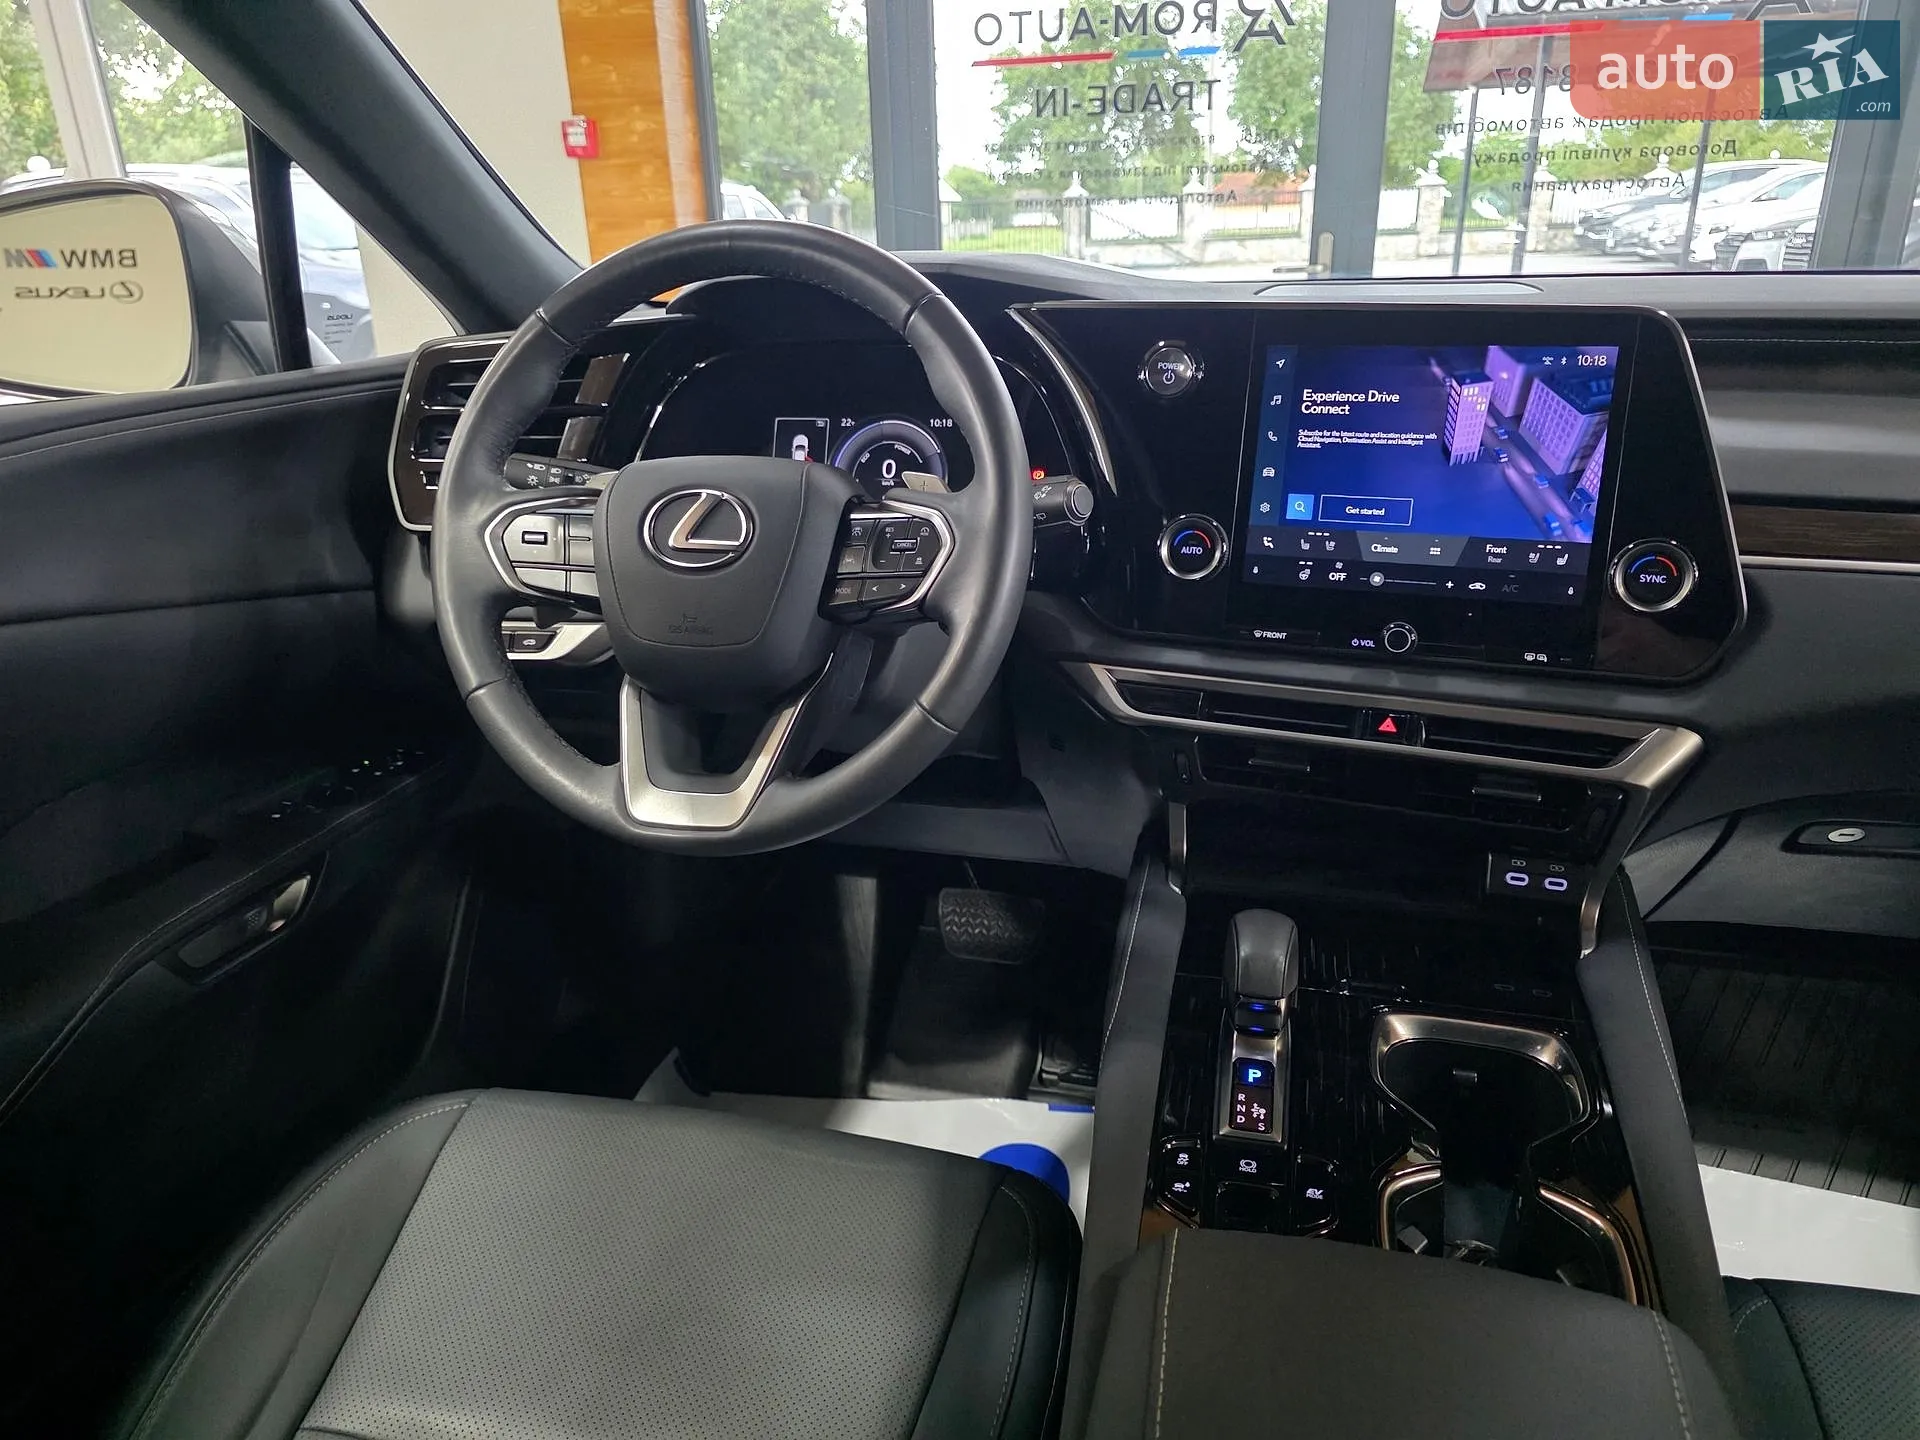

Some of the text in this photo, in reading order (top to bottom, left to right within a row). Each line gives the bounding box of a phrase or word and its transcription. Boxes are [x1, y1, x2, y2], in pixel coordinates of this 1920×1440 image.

[1576, 354, 1607, 367] 10:18
[1302, 389, 1400, 404] Experience Drive
[1301, 402, 1351, 415] Connect
[929, 418, 953, 428] 10:18
[882, 458, 897, 479] 0
[1345, 505, 1386, 516] Get started
[1180, 546, 1203, 555] AUTO
[1371, 543, 1399, 555] Climate
[1485, 544, 1507, 555] Front
[1487, 555, 1502, 564] Rear
[1328, 572, 1348, 582] OFF
[1639, 574, 1667, 584] SYNC
[1502, 584, 1520, 593] A/C
[1263, 630, 1287, 640] FRONT
[1360, 639, 1376, 648] VOL
[1247, 1068, 1262, 1082] P
[1237, 1093, 1246, 1102] R
[1236, 1104, 1246, 1112] N
[1236, 1115, 1246, 1123] D
[1257, 1122, 1266, 1132] S
